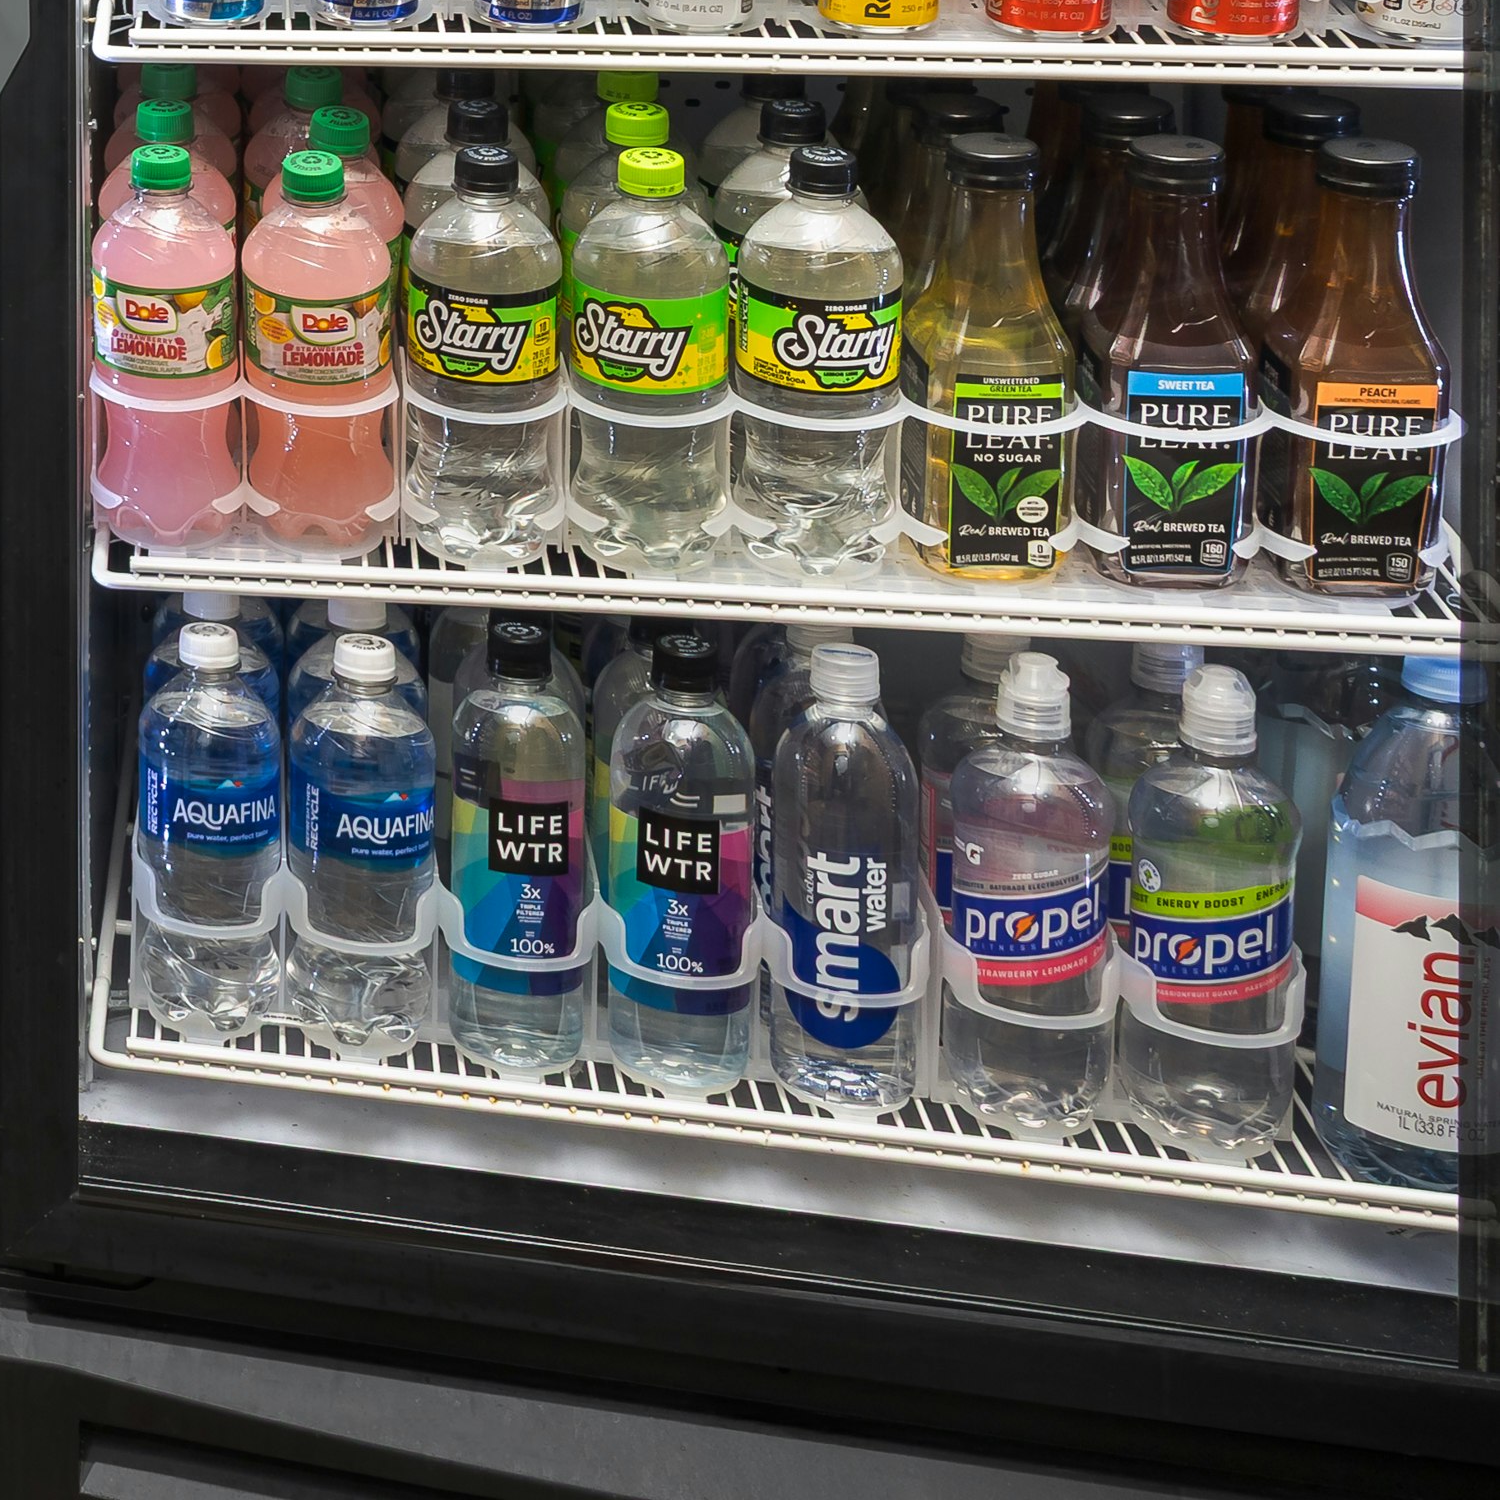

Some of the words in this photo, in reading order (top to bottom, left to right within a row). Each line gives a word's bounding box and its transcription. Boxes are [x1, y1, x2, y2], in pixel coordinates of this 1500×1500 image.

[575, 301, 687, 376] Starry
[982, 376, 1040, 385] UNSWEETENED
[989, 384, 1015, 394] GREEN
[1016, 384, 1033, 394] TEA
[1156, 379, 1193, 391] SWEET
[1194, 379, 1216, 391] TEA
[1358, 386, 1398, 399] PEACH
[1139, 402, 1232, 428] PURE
[972, 453, 992, 463] NO
[994, 453, 1042, 463] SUGAR
[958, 523, 987, 537] Real
[987, 525, 1031, 537] BREWED
[1033, 526, 1051, 537] TEA
[172, 795, 277, 830] AQUAFINA
[497, 812, 563, 838] LIFE
[496, 841, 564, 865] WTR
[520, 883, 542, 901] 3x
[864, 857, 888, 933] water
[1156, 895, 1200, 910] ENERGY
[1203, 893, 1246, 909] BOOST
[509, 937, 556, 956] 100%
[806, 851, 862, 1023] smart
[1134, 914, 1274, 975] propel
[1407, 950, 1474, 1111] evian
